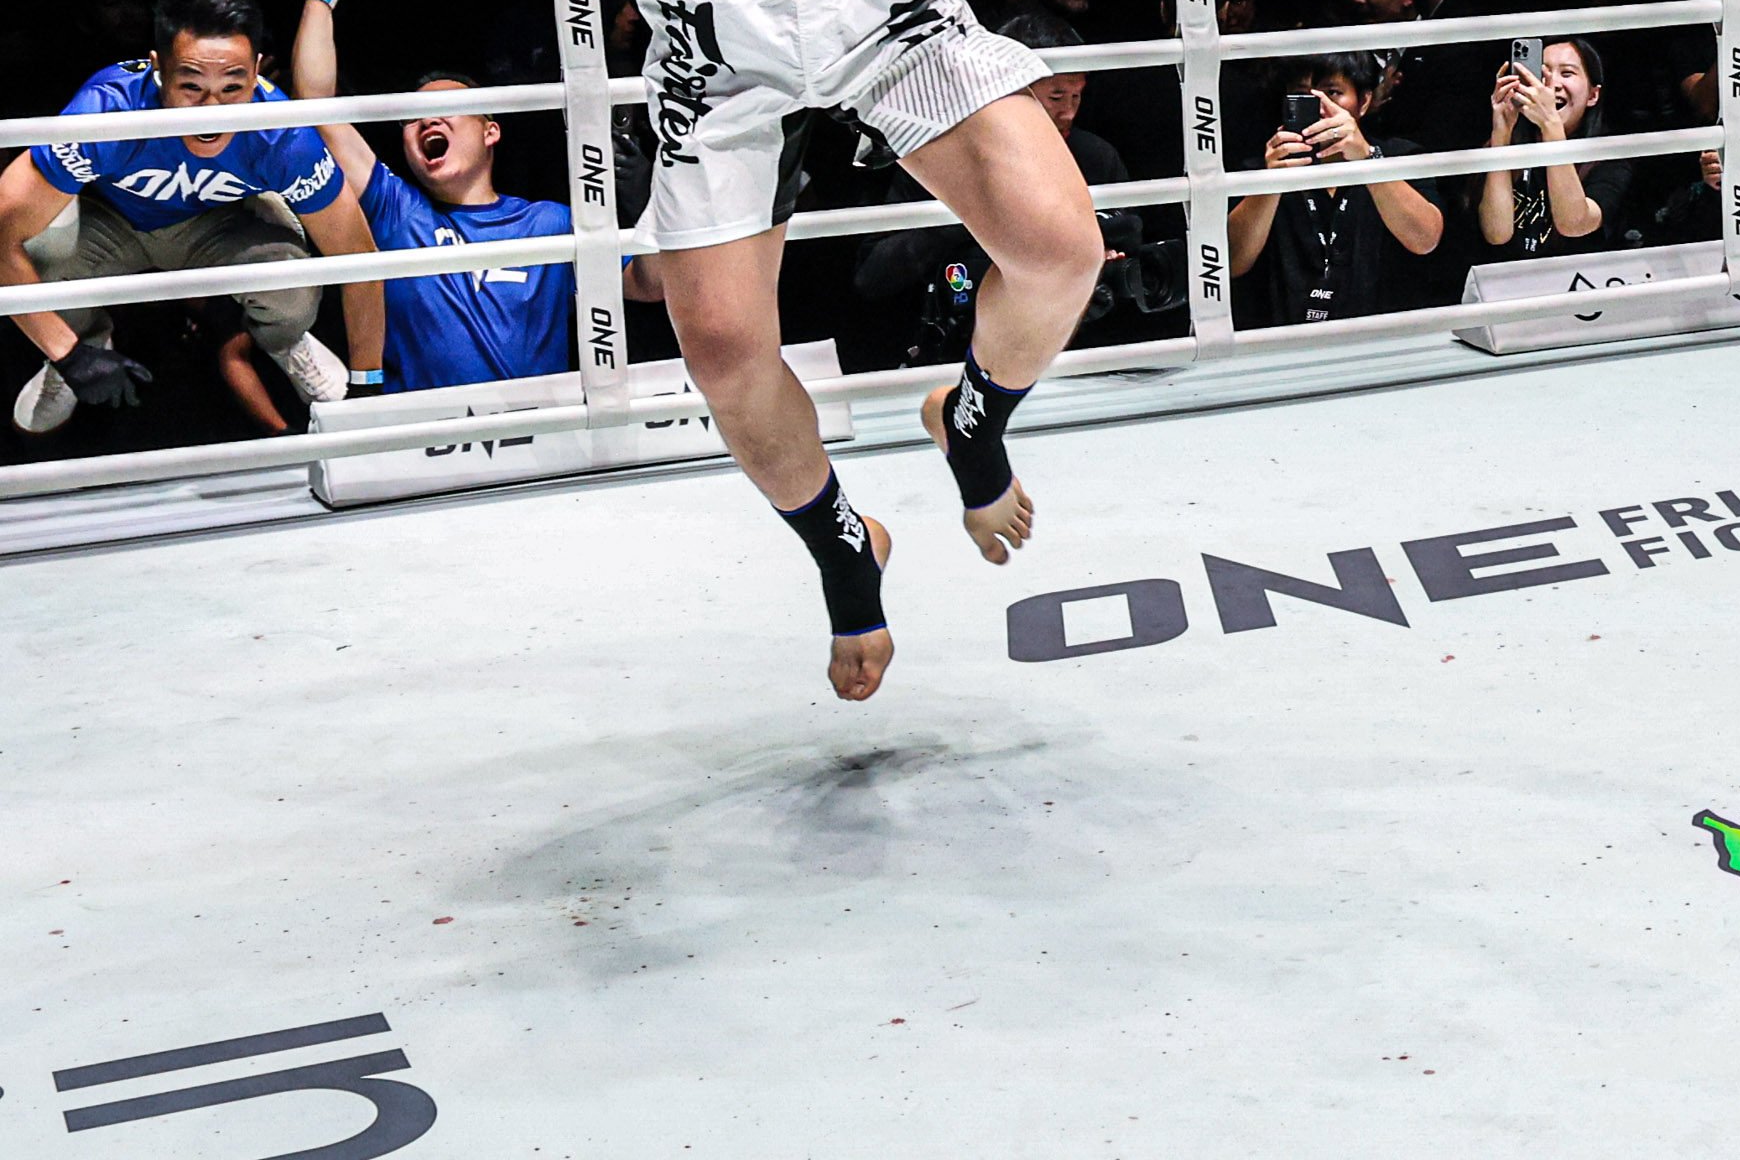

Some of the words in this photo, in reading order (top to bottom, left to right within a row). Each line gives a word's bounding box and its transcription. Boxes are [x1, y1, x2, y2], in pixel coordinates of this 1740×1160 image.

[656, 0, 737, 168] Fairtex
[1192, 95, 1218, 155] ONE
[51, 142, 101, 185] airtex
[112, 160, 264, 203] ONE
[577, 143, 609, 207] ONE
[1198, 243, 1225, 302] ONE
[587, 306, 619, 370] ONE
[1006, 515, 1612, 663] ONE
